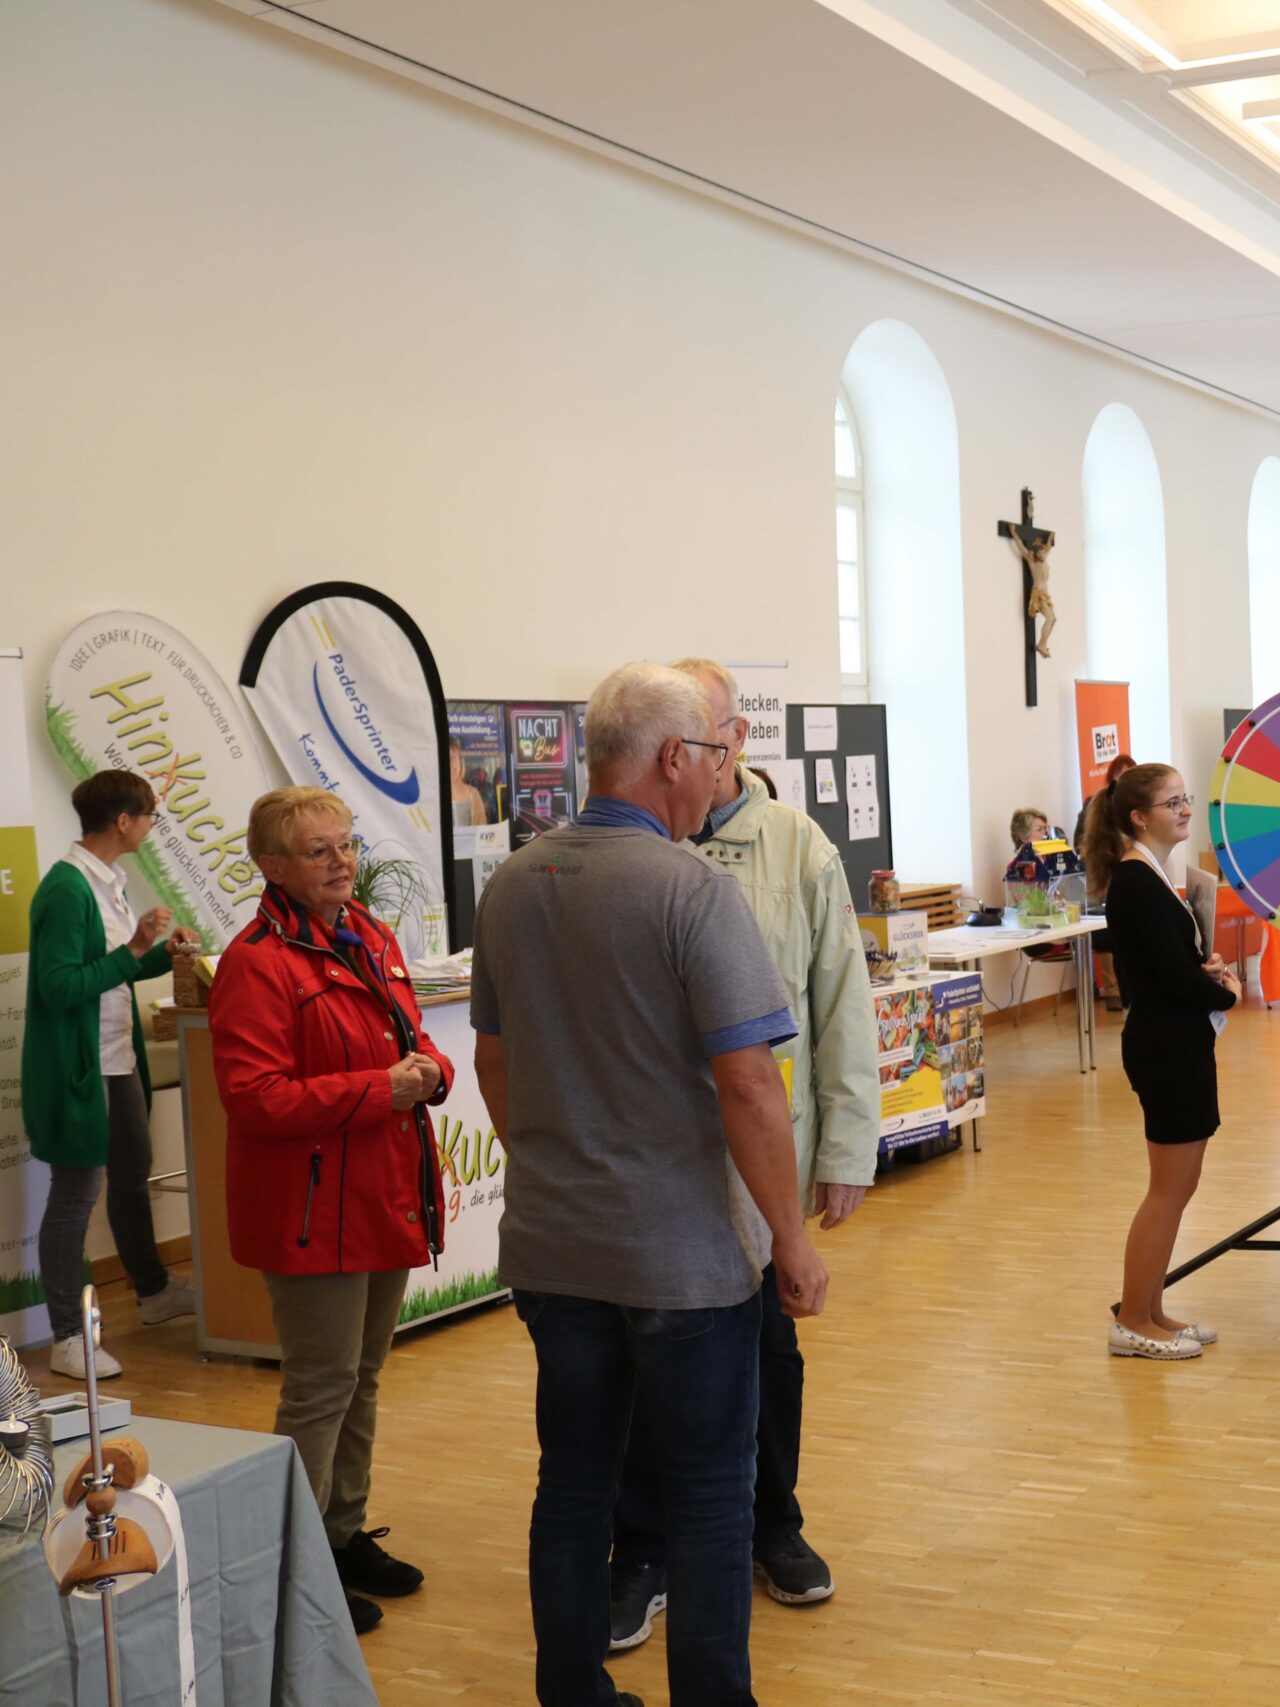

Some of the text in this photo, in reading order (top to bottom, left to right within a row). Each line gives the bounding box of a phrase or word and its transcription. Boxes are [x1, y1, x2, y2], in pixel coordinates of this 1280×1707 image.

[70, 650, 90, 672] IDEE
[92, 629, 131, 650] GRAFIK
[140, 632, 166, 653] TEXT
[166, 650, 187, 672] FÜR
[182, 668, 231, 735] DRUCKSACHEN
[230, 746, 244, 760] CO
[329, 653, 398, 773] PaderSprinter
[518, 718, 558, 739] NACHT
[534, 736, 560, 761] Bus
[1095, 731, 1116, 749] Brot
[299, 733, 340, 794] Kommt
[165, 836, 206, 894] glücklich
[203, 890, 236, 930] macht
[470, 1189, 484, 1206] die
